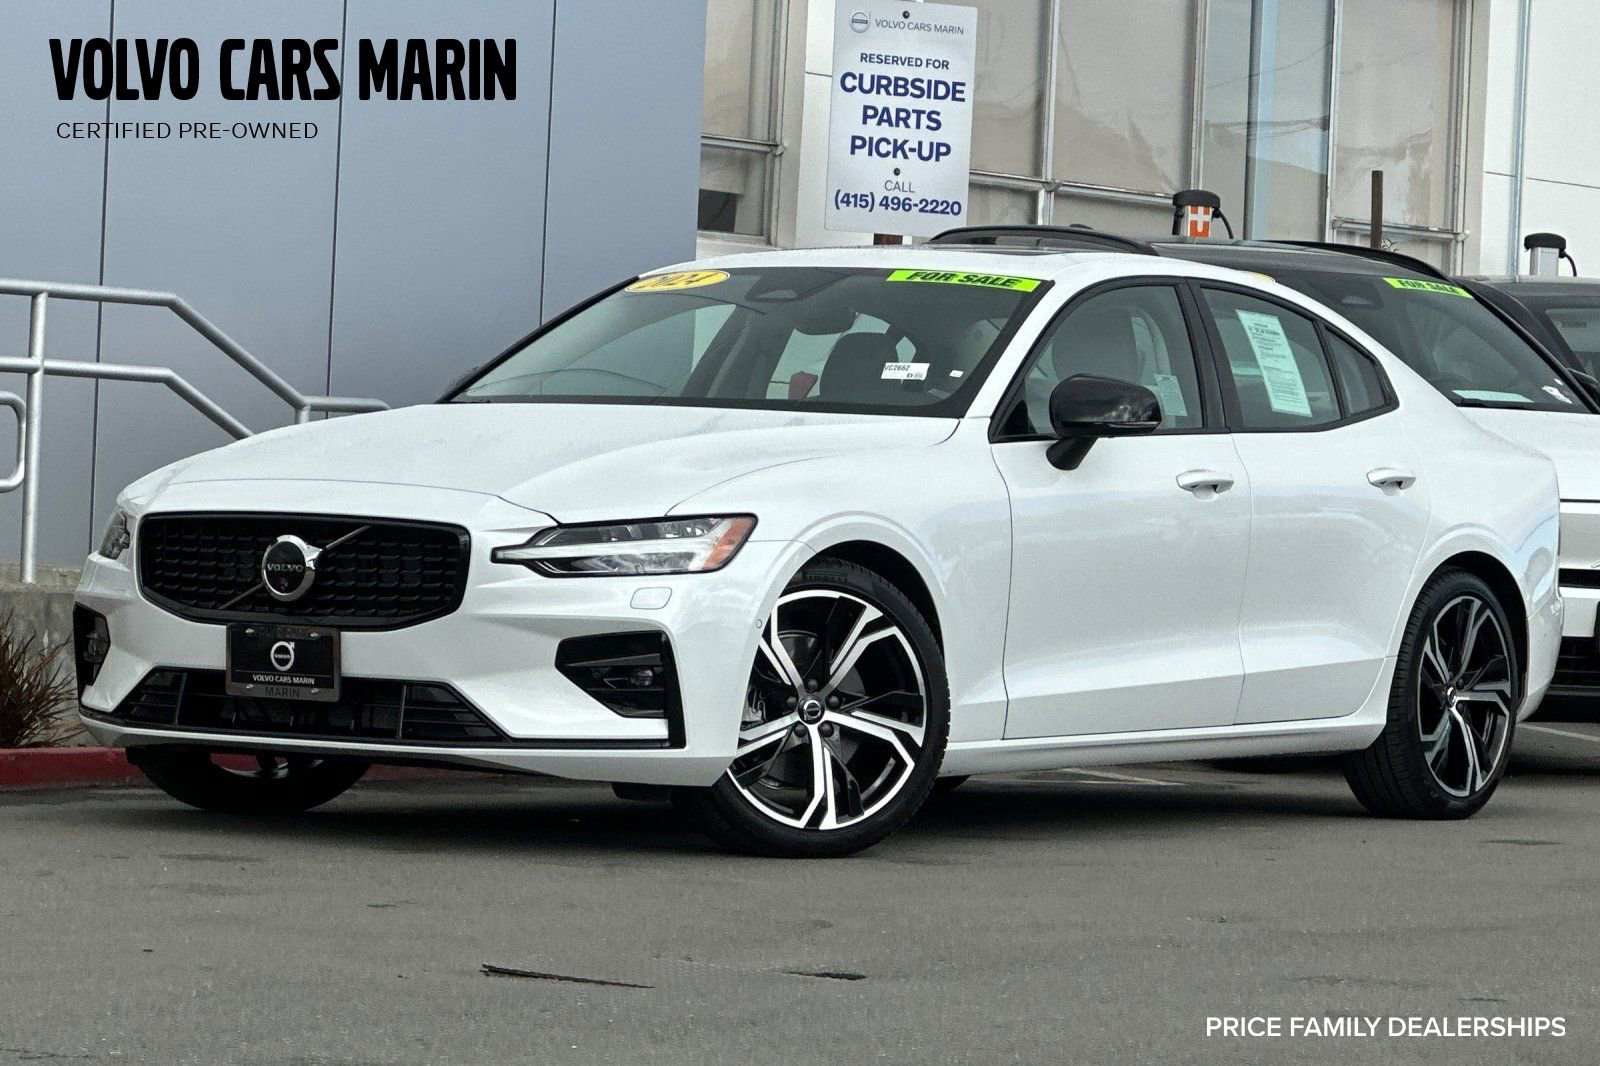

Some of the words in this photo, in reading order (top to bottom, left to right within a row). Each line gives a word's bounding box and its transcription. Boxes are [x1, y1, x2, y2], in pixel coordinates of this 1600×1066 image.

[875, 18, 906, 30] VOLVO
[907, 21, 933, 32] CARS
[934, 25, 964, 35] MARIN
[860, 52, 923, 67] RESERVED
[925, 58, 950, 70] FOR
[840, 71, 966, 102] CURBSIDE
[862, 105, 942, 131] PARTS
[850, 135, 951, 162] PICK-UP
[884, 180, 916, 193] CALL
[834, 189, 875, 212] (415)
[879, 195, 962, 216] 496-2220
[906, 272, 955, 281] FOR
[959, 274, 1021, 287] SALE
[1397, 279, 1426, 288] FOR
[1426, 282, 1459, 293] SALE
[267, 563, 304, 572] VOLVO
[252, 674, 274, 682] VOLVO
[275, 675, 292, 684] CARS
[292, 676, 315, 685] MARIN
[265, 686, 301, 698] MARIN
